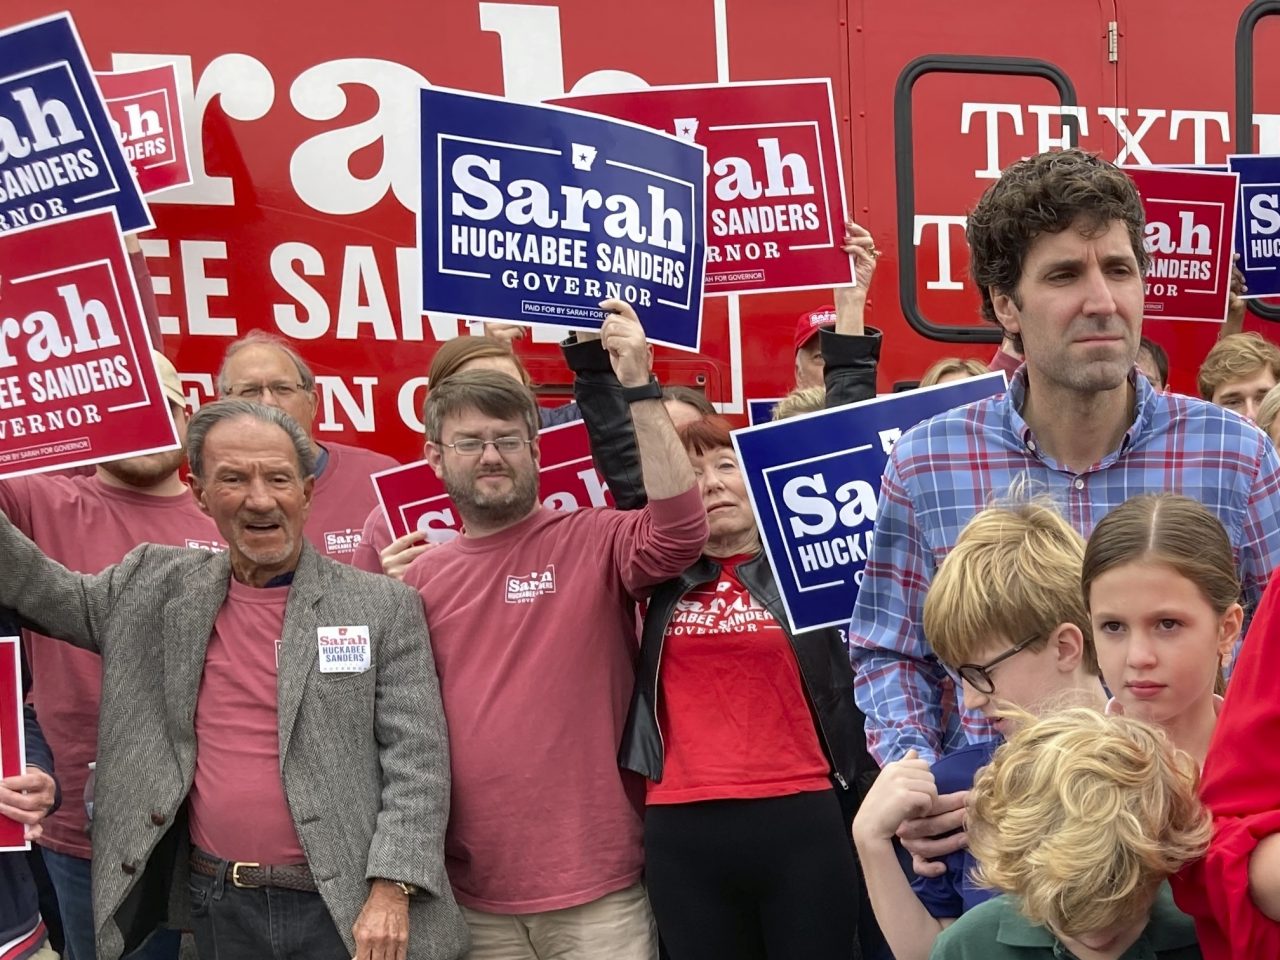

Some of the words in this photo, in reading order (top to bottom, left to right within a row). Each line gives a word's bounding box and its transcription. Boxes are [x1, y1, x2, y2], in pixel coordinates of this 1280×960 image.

[451, 154, 686, 254] Sarah
[712, 203, 820, 237] SANDERS
[451, 224, 587, 270] HUCKABEE
[596, 242, 684, 290] SANDERS
[728, 272, 762, 281] GOVERNOR
[1146, 258, 1212, 280] ANDERS
[502, 271, 651, 307] GOVERNOR
[566, 308, 588, 317] SARAH
[28, 355, 132, 403] SANDERS
[40, 447, 53, 455] FOR
[54, 441, 88, 453] GOVERNOR
[320, 635, 367, 646] Sarah
[322, 646, 366, 654] HUCKABEE
[326, 654, 364, 662] SANDERS
